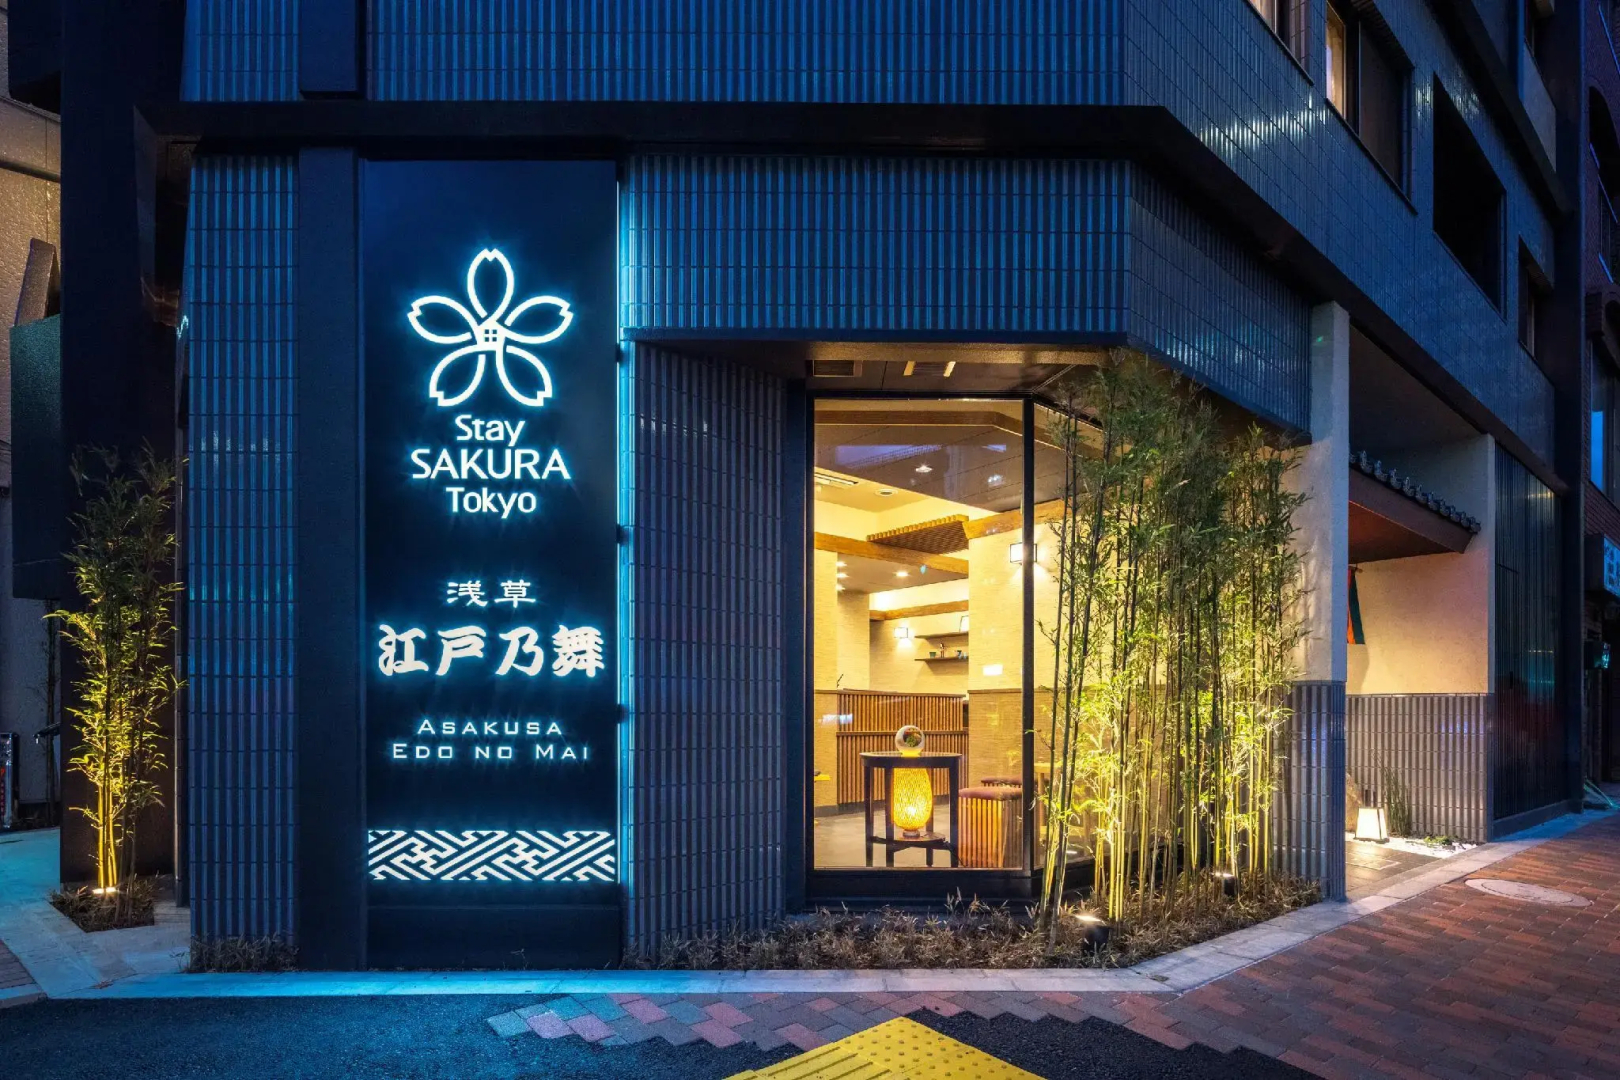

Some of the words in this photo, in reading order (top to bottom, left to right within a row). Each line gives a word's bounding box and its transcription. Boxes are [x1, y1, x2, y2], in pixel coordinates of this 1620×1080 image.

[454, 414, 526, 447] Stay
[410, 448, 572, 480] SAKURA
[445, 486, 537, 519] Tokyo
[446, 579, 537, 608] 浅草
[378, 624, 605, 678] 江戸乃舞
